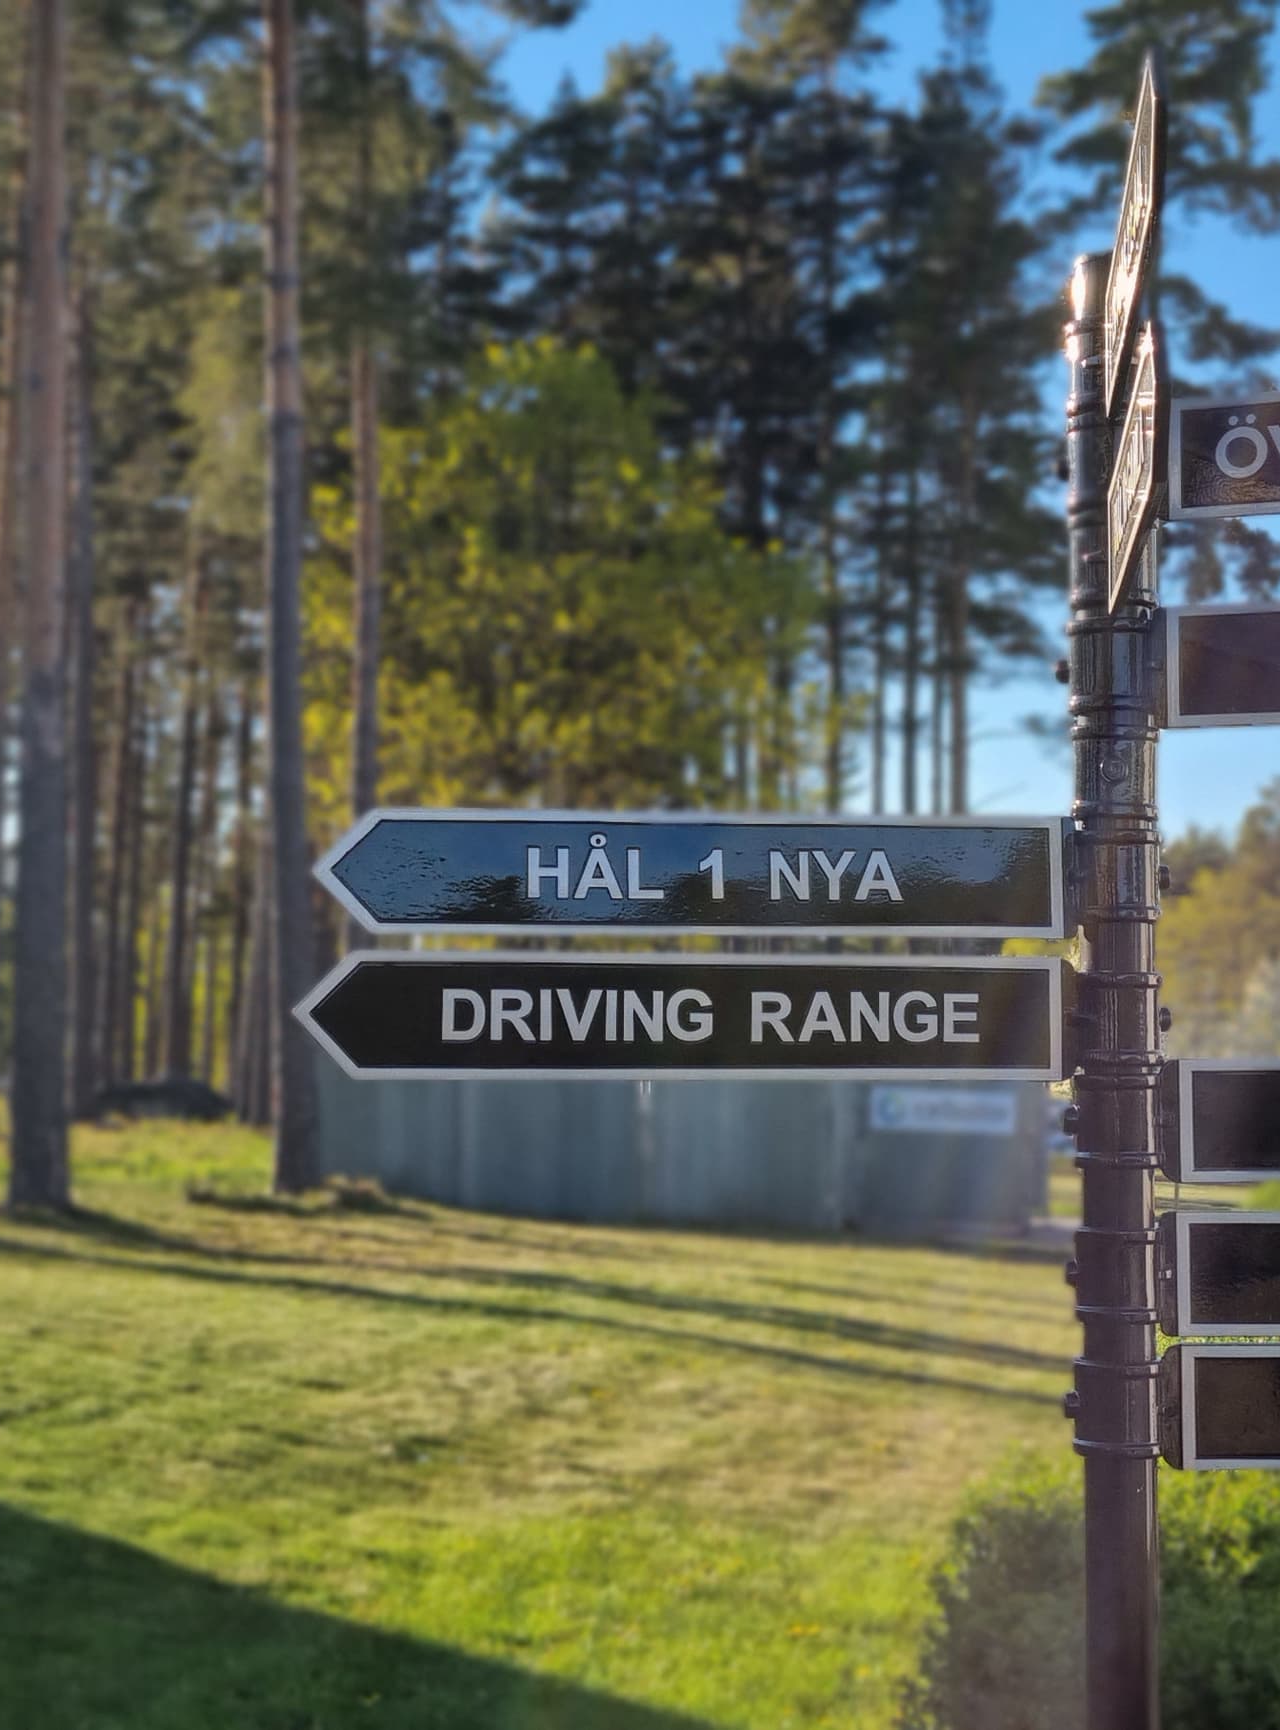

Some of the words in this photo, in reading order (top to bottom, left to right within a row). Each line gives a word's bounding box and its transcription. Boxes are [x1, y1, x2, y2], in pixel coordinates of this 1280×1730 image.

[528, 833, 664, 899] HÅL
[700, 850, 724, 899] 1
[770, 851, 903, 900] NYA
[442, 989, 713, 1041] DRIVING
[751, 991, 979, 1042] RANGE
